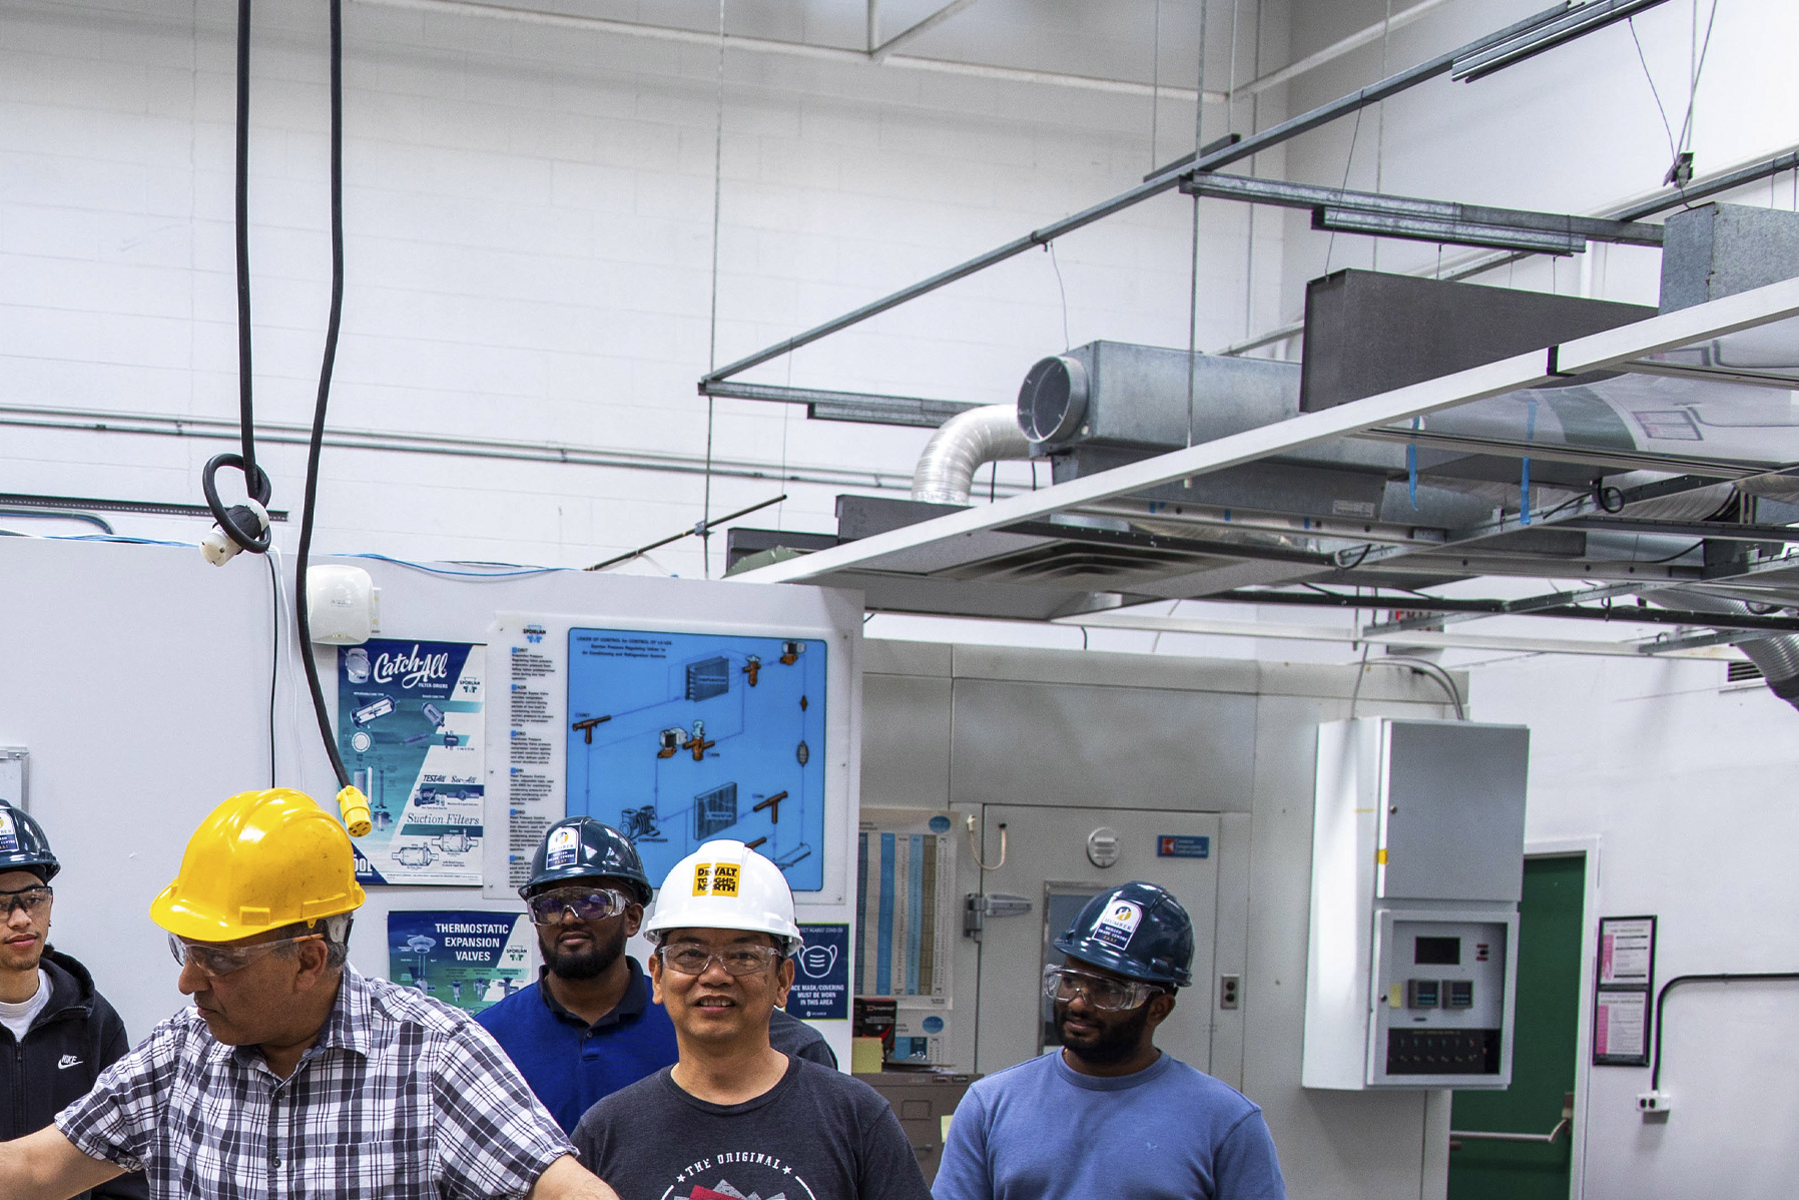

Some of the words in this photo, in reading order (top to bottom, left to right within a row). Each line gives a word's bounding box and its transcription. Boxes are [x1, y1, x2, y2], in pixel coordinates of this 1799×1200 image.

[407, 813, 444, 824] Suction
[446, 813, 480, 825] Filters
[435, 923, 509, 935] THERMOSTATIC
[445, 937, 500, 948] EXPANSION
[455, 951, 491, 962] VALVES
[685, 1158, 711, 1177] THE
[717, 1152, 781, 1170] ORIGINAL
